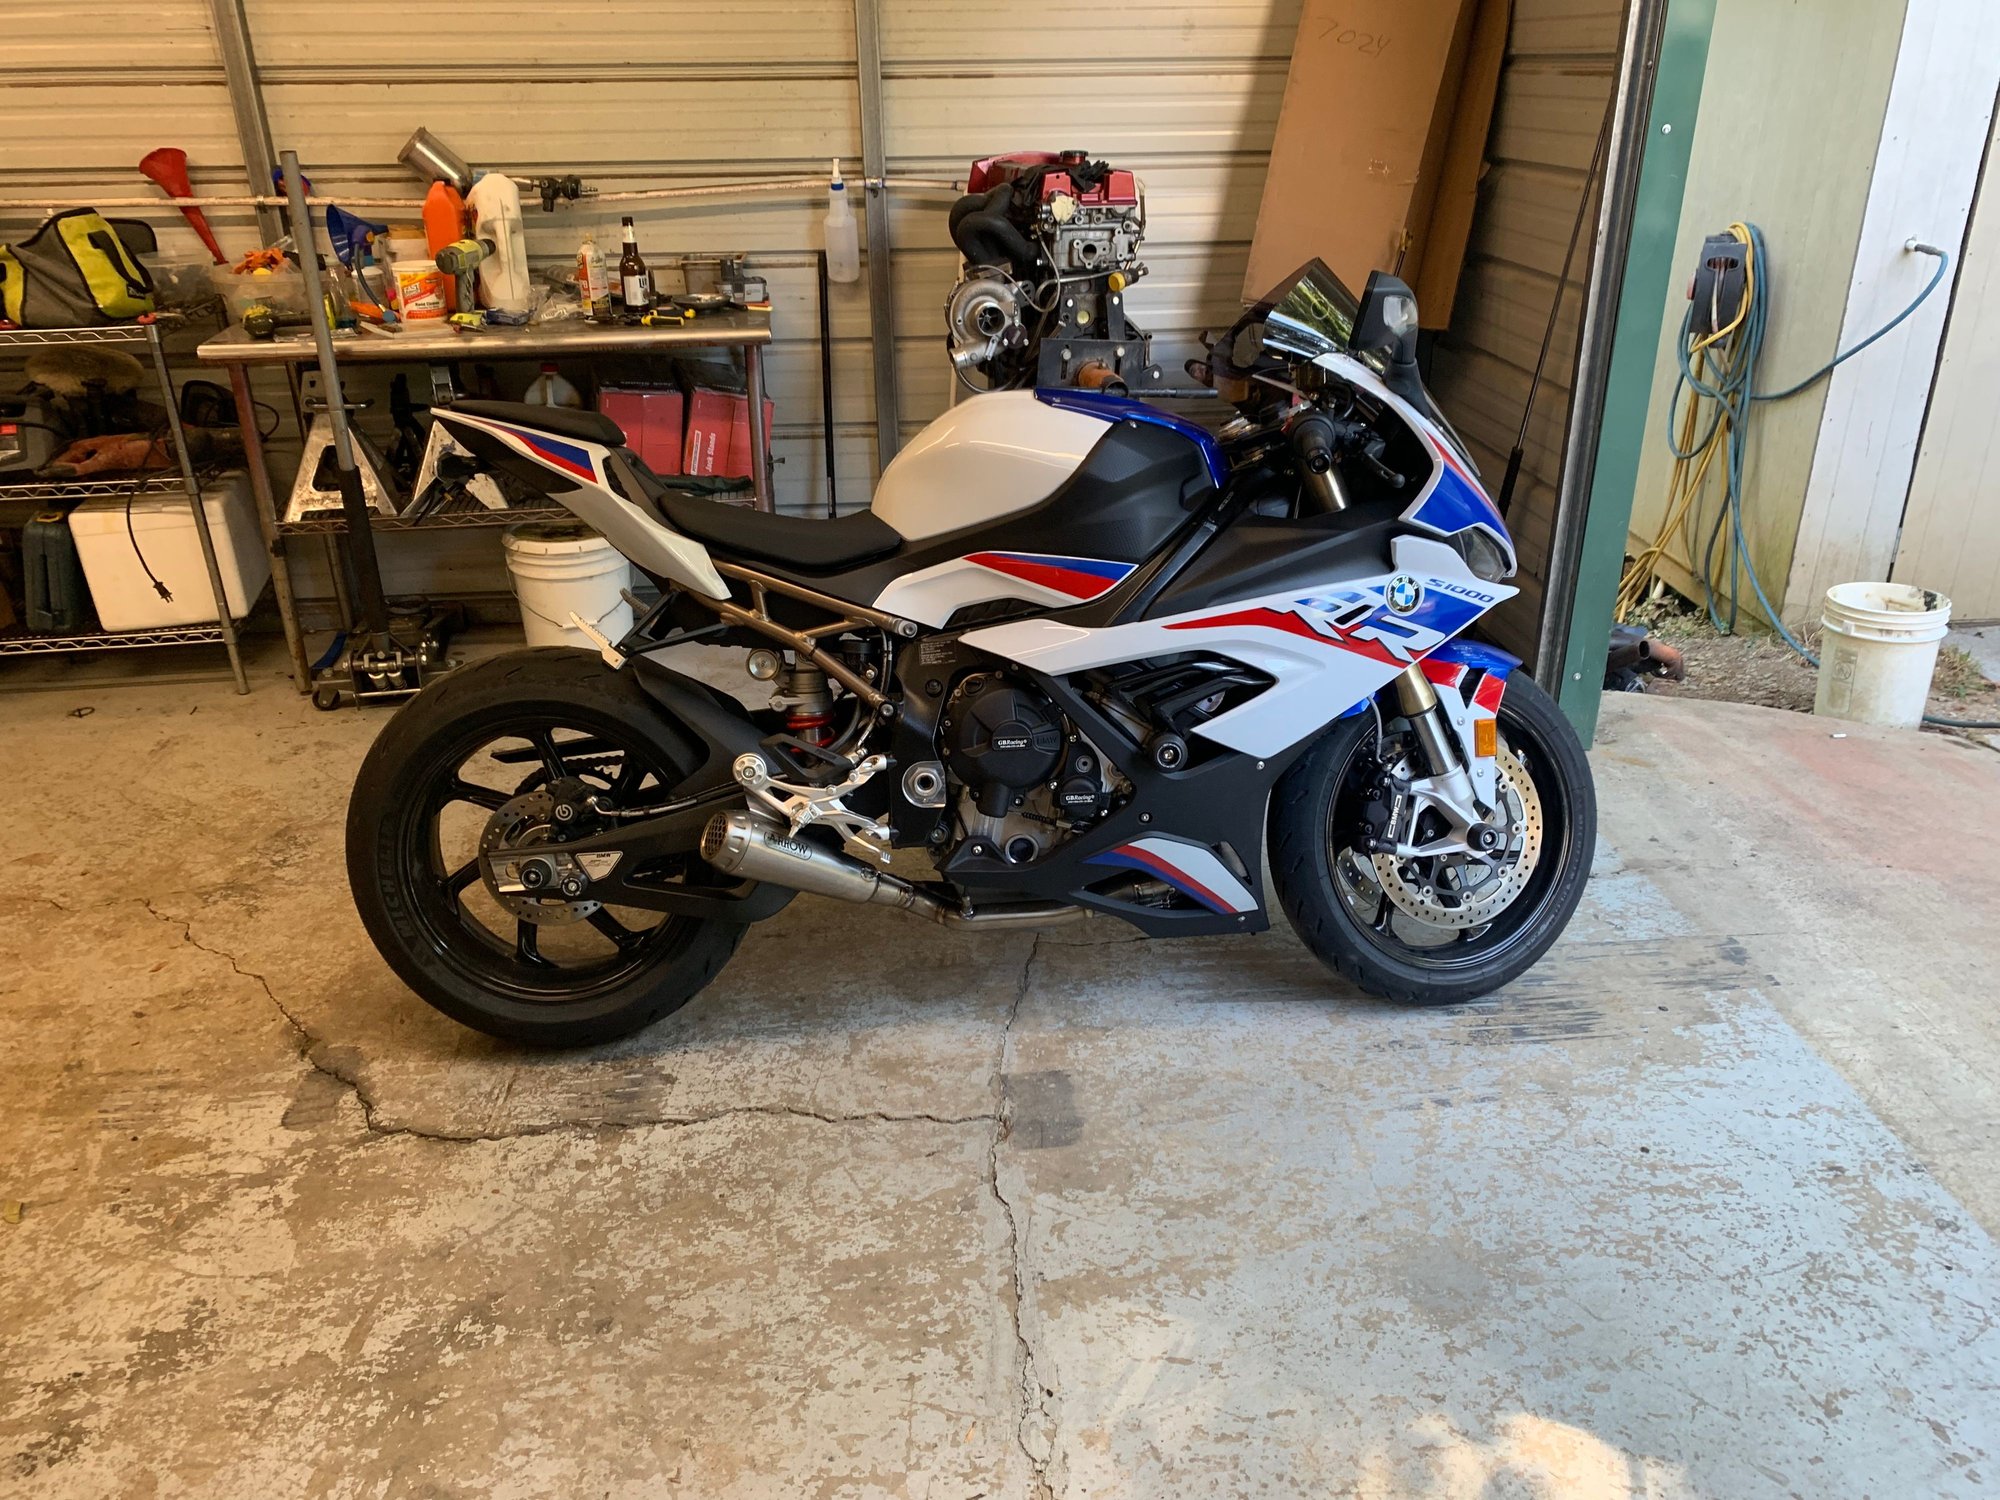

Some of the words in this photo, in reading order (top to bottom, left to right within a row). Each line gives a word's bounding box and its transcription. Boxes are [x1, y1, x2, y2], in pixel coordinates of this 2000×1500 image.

[1317, 17, 1392, 57] 7024
[1424, 578, 1496, 603] S1000
[767, 833, 809, 855] ARROW
